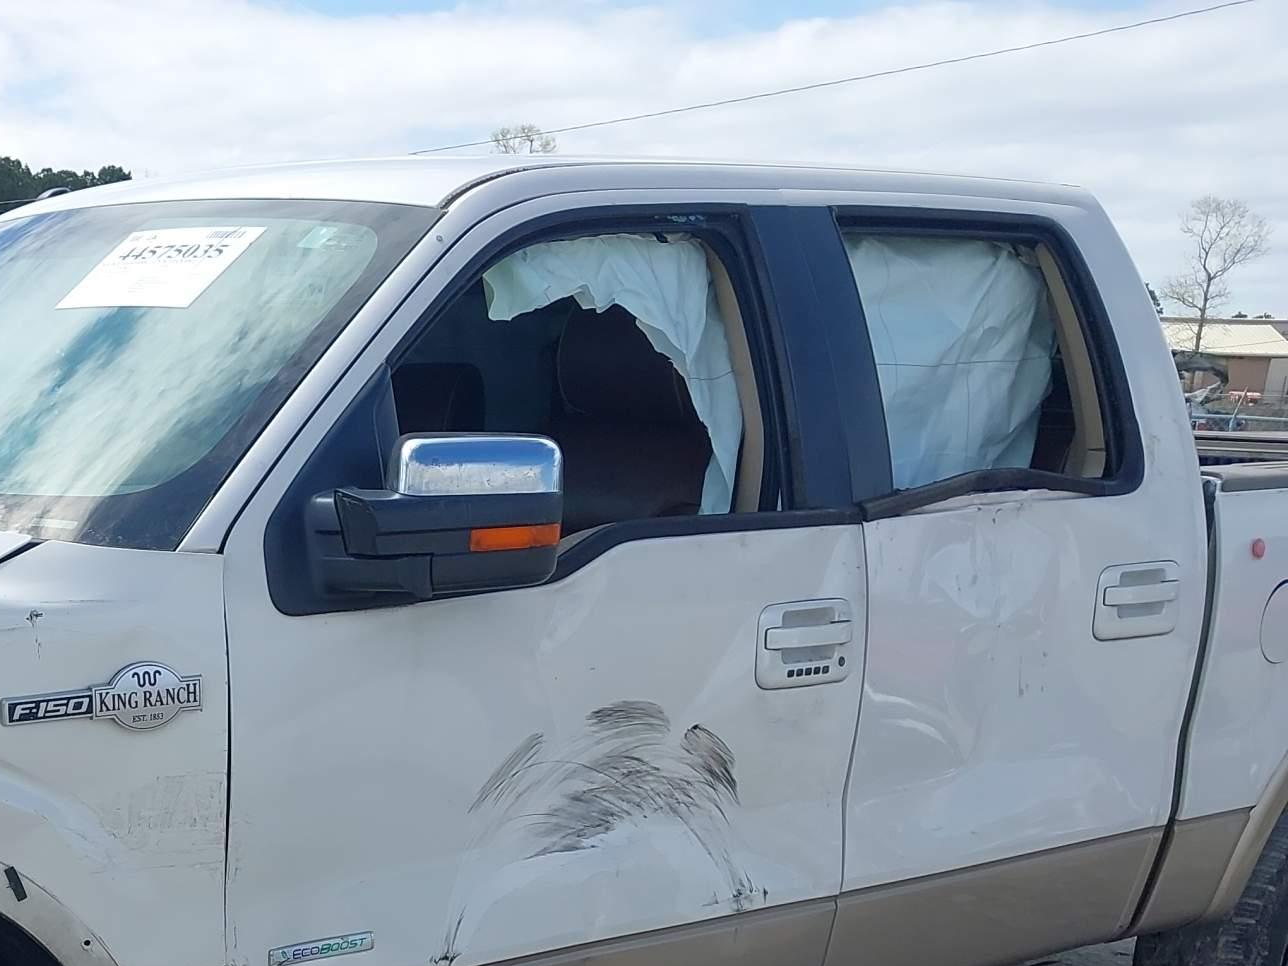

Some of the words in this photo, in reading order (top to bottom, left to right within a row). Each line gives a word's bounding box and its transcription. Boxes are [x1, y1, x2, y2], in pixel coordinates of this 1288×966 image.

[118, 243, 230, 261] 44575035
[98, 691, 139, 713] KING
[143, 682, 199, 708] RANCH
[12, 697, 91, 721] F-150
[132, 713, 148, 724] EST.
[149, 712, 164, 722] 1853
